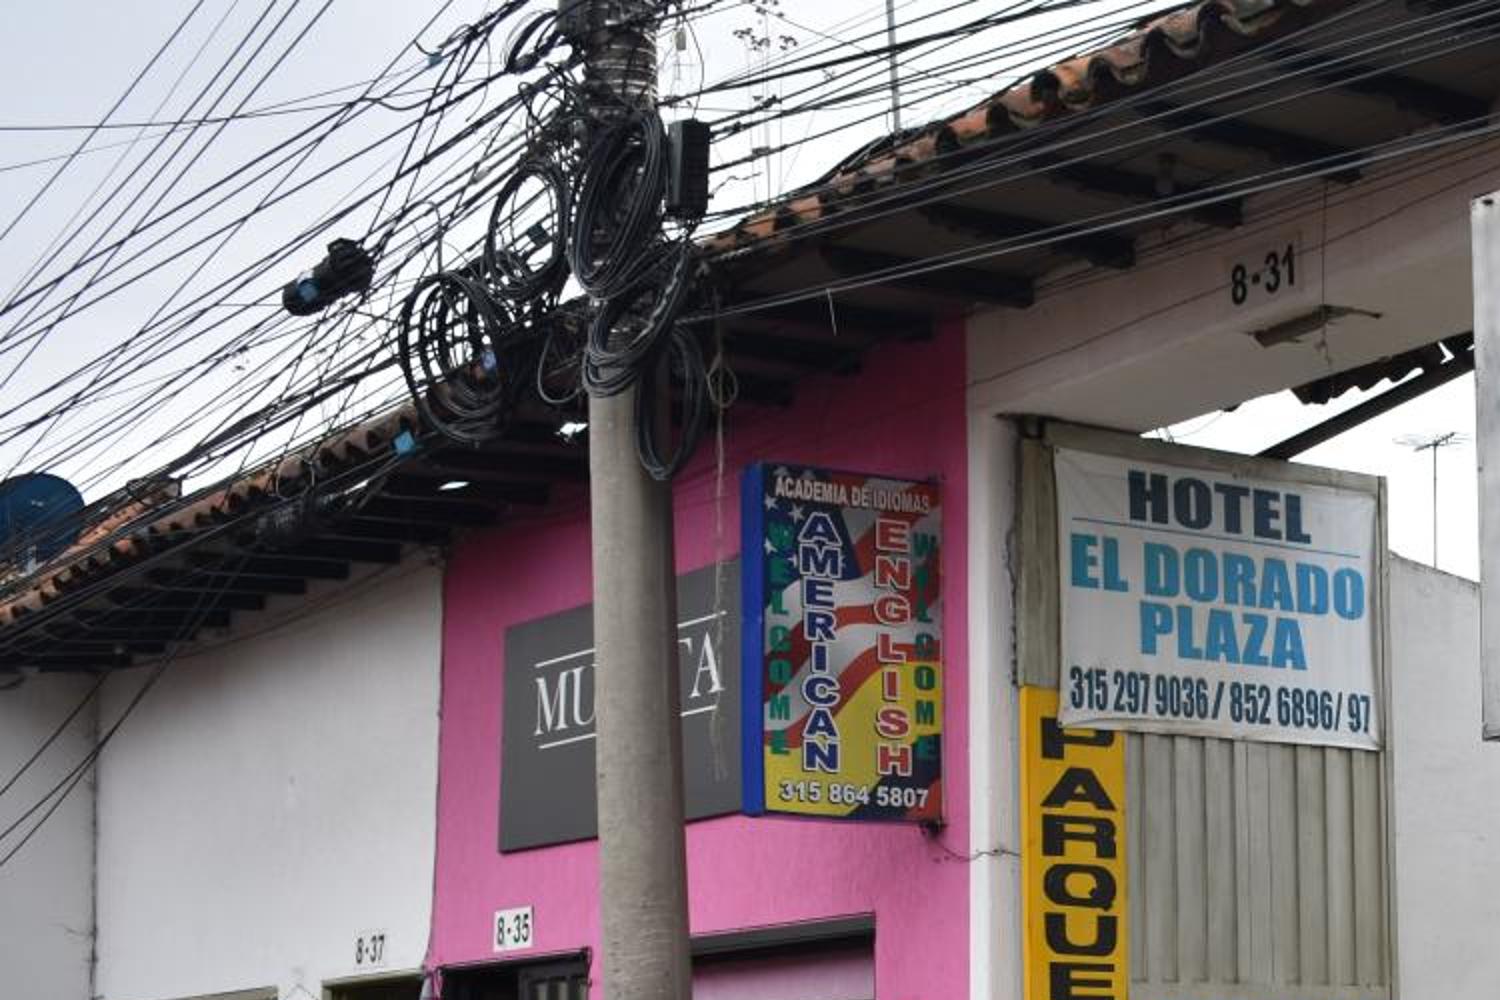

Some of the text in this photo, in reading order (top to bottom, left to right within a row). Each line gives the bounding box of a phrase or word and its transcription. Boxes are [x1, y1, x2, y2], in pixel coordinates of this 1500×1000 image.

[775, 476, 930, 514] ACADEMIA DE IDIOMAS
[1127, 469, 1312, 544] HOTEL
[1070, 533, 1366, 621] EL DORADO
[798, 512, 842, 774] AMERICAN
[874, 517, 913, 778] ENGLISH
[1140, 601, 1308, 671] PLAZA
[1070, 665, 1108, 713] 315
[1113, 670, 1149, 716] 297
[1156, 674, 1209, 720] 9036
[1230, 682, 1272, 725] 852
[1349, 693, 1371, 734] 97
[780, 781, 929, 808] 315 864 5807
